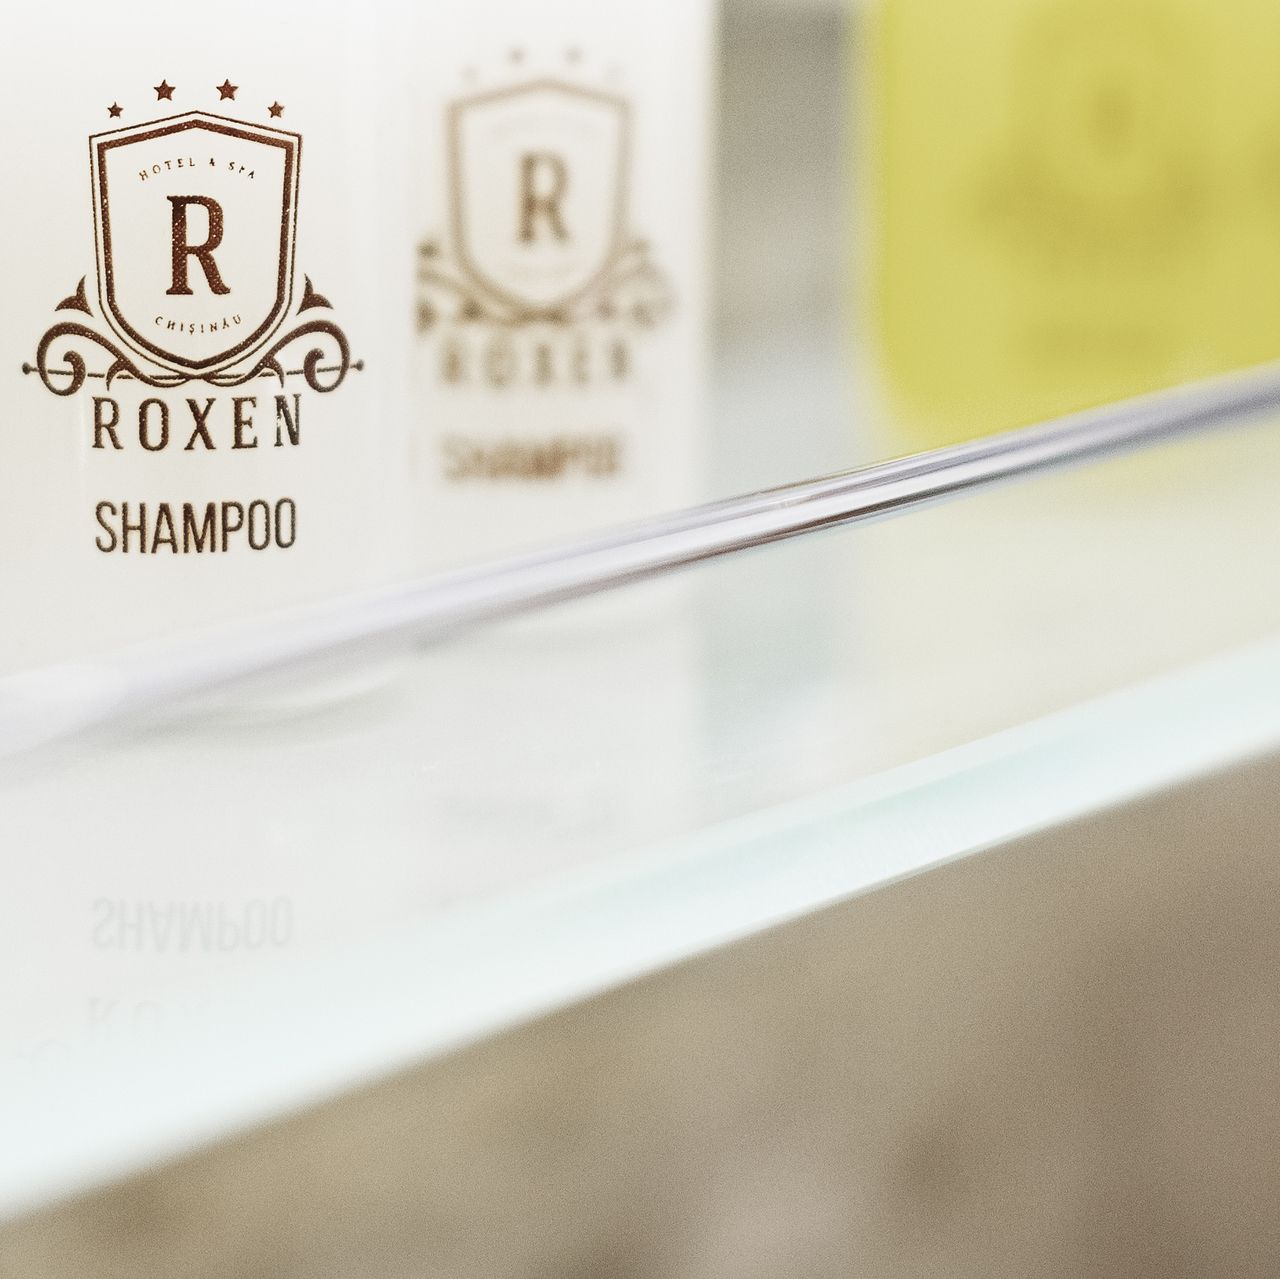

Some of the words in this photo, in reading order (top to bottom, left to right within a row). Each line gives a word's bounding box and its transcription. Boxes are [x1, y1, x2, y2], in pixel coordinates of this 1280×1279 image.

[138, 157, 196, 182] HOTEL
[517, 151, 571, 248] R
[165, 194, 232, 296] R
[91, 393, 303, 453] ROXEN
[94, 497, 298, 556] SHAMPOO
